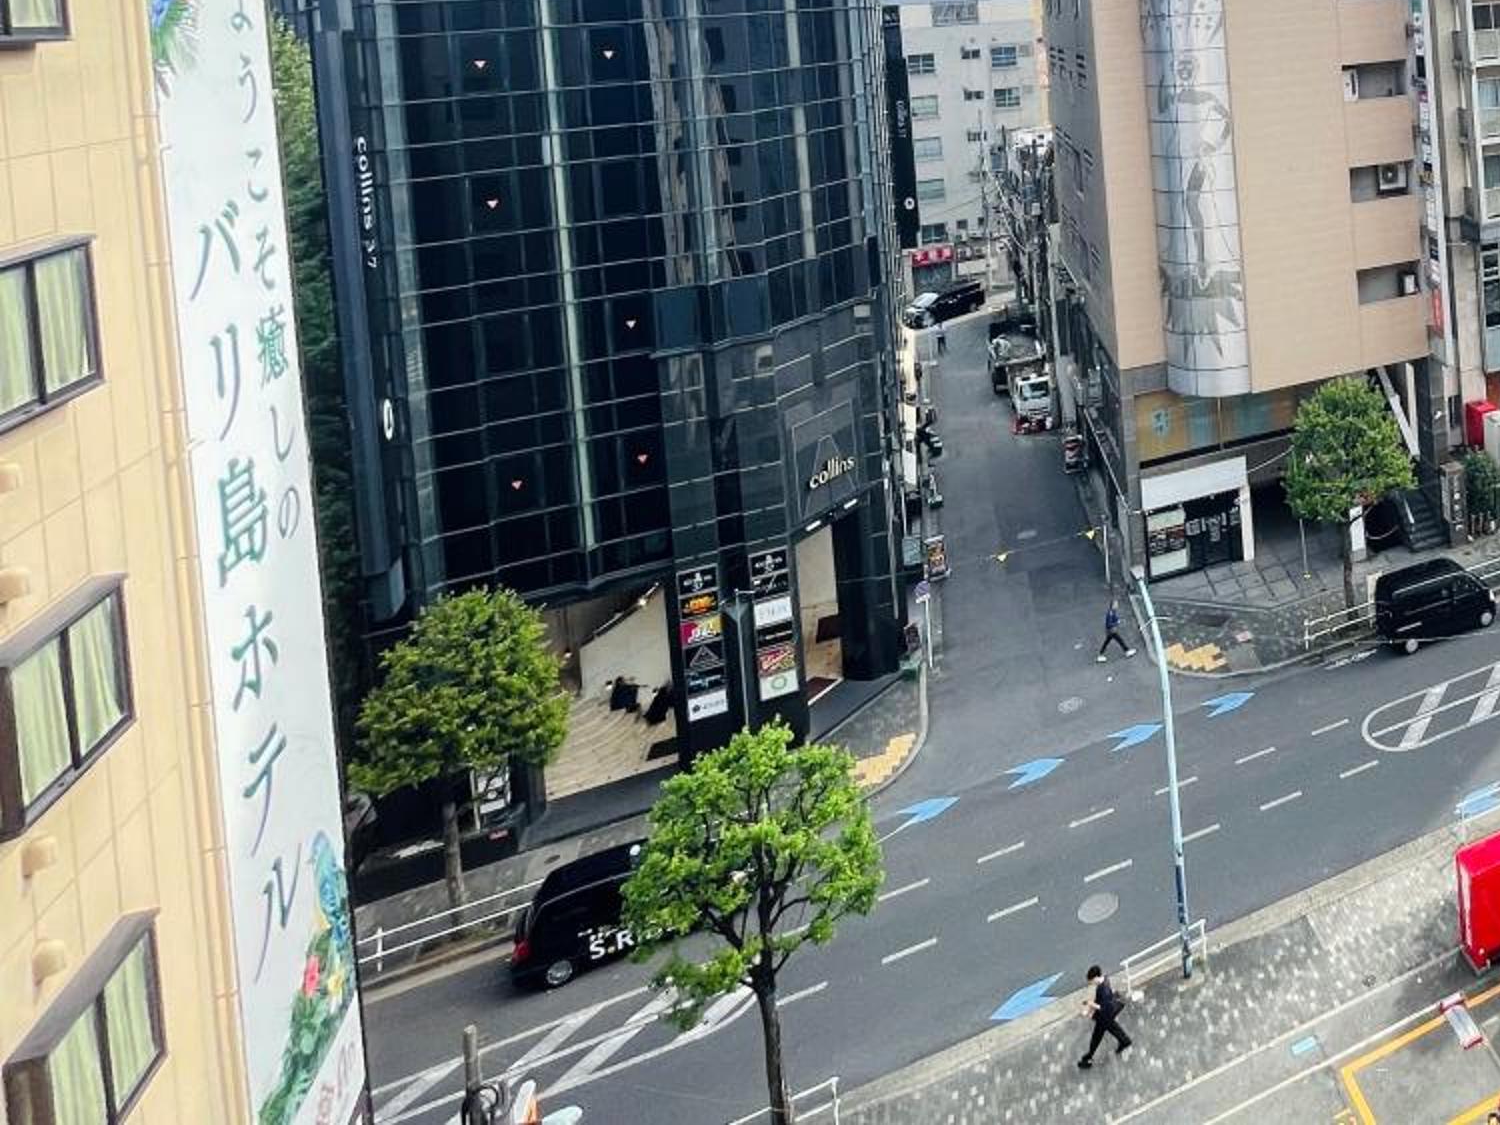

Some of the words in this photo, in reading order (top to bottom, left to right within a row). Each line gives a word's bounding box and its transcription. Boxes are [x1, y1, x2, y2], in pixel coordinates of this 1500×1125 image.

[188, 198, 302, 984] バリ島ホテル
[808, 455, 856, 490] collins
